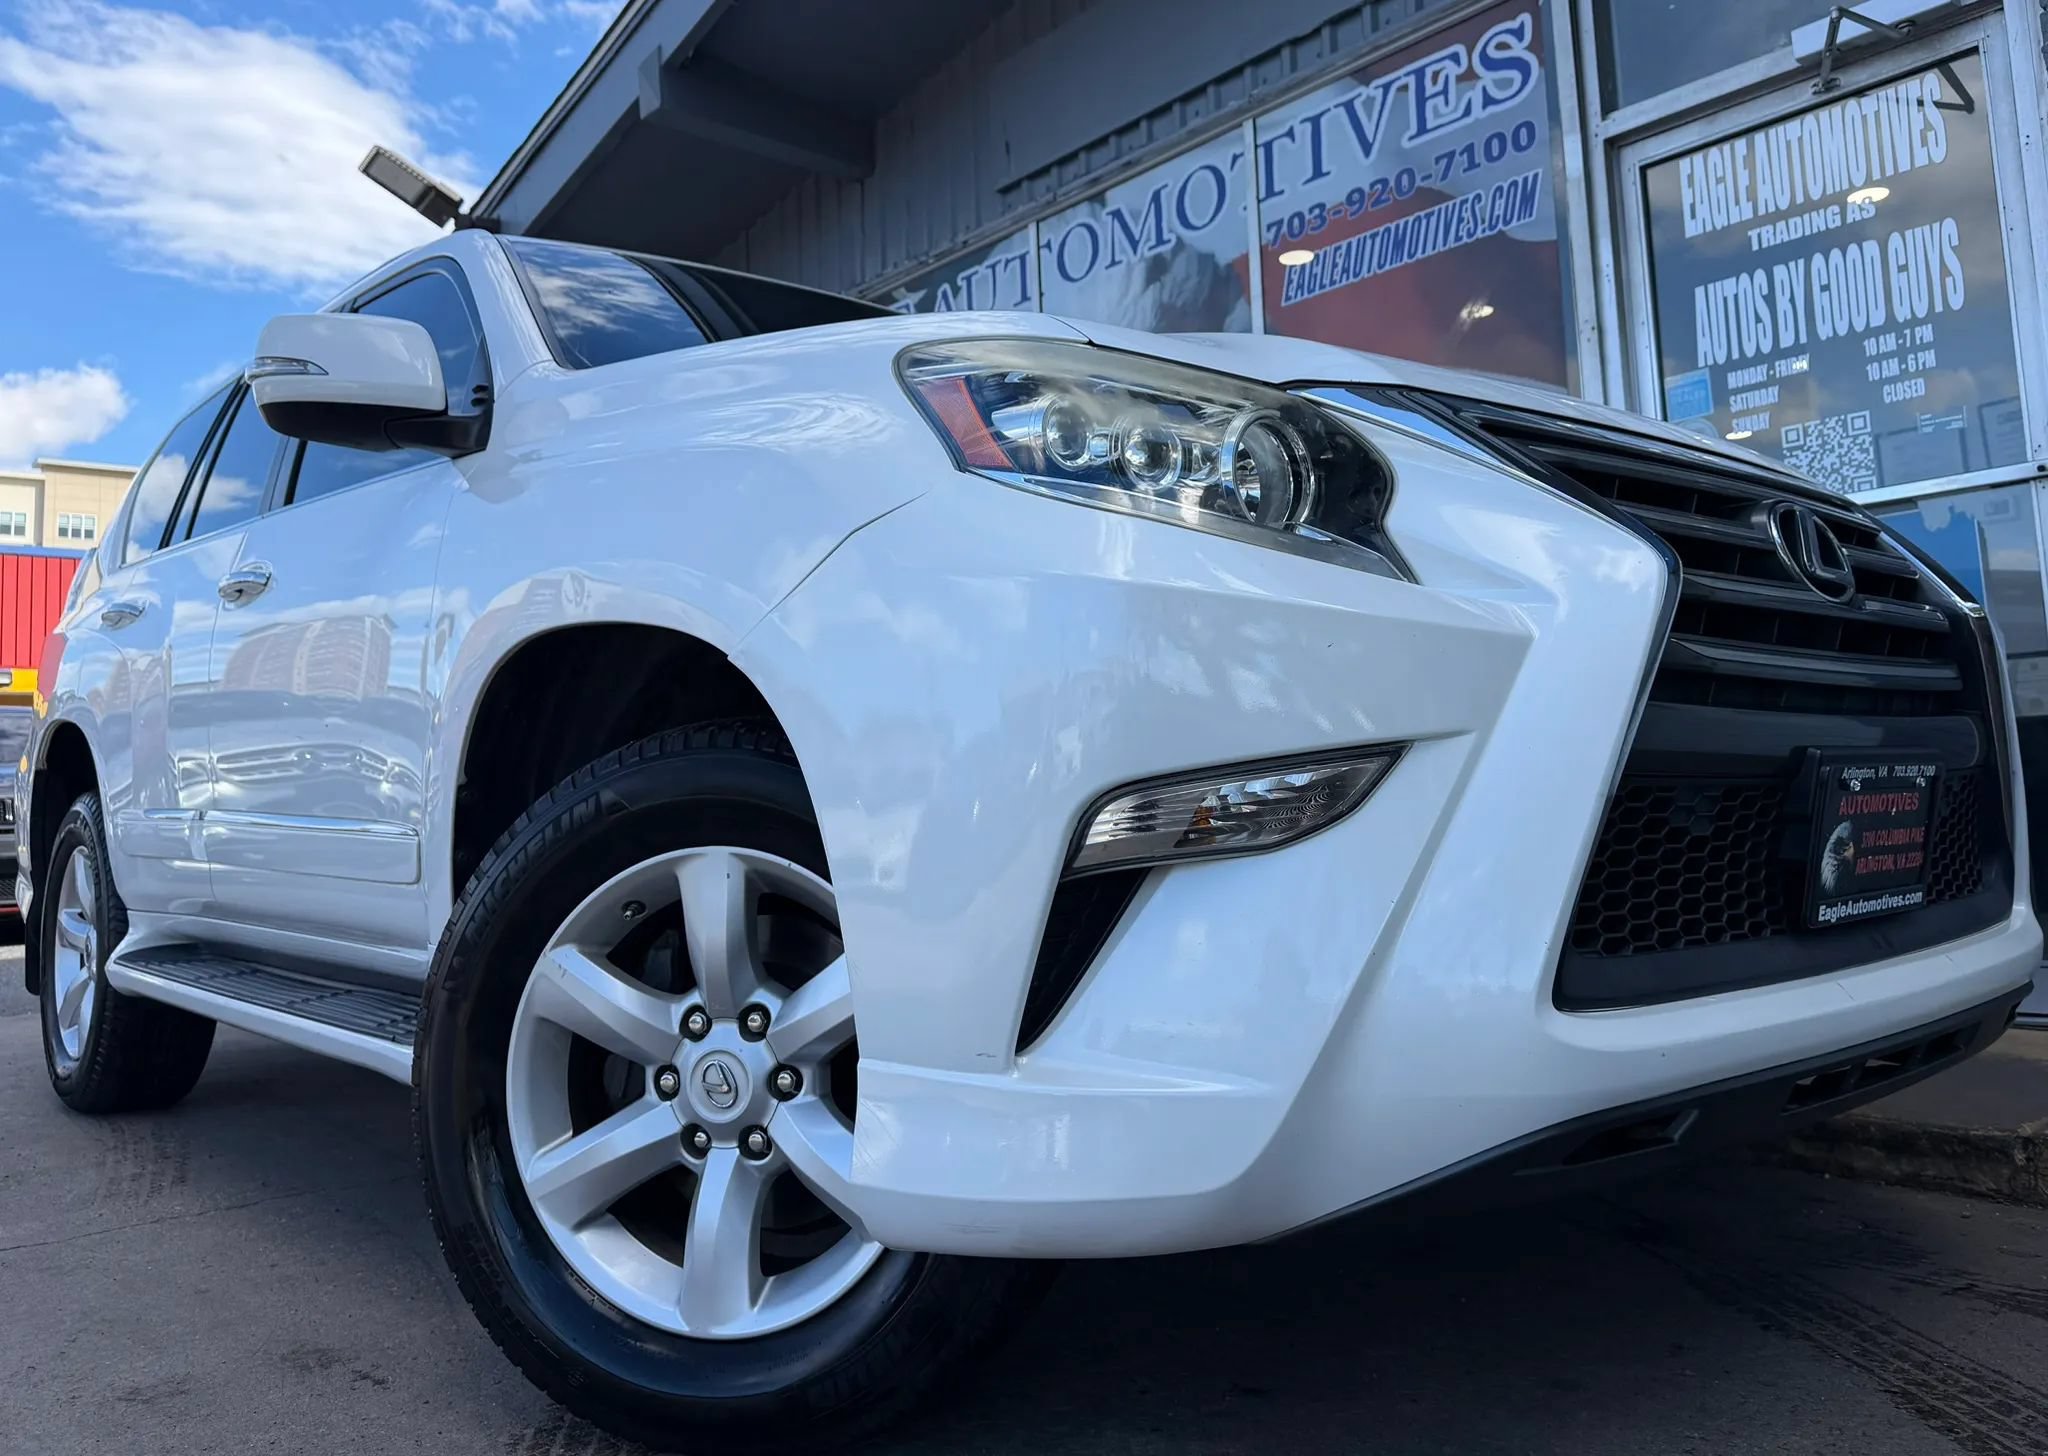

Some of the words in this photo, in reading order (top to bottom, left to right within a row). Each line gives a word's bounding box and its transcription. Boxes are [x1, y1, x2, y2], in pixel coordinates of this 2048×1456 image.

[1679, 139, 1754, 238] EAGLE
[1755, 72, 1947, 215] AUTOMOTIVES
[1266, 120, 1537, 249] 703-920-7100
[1282, 170, 1542, 306] EAGLEAUTOMOTIVES.COM
[1747, 204, 1842, 251] TRADING
[1846, 197, 1877, 226] AS
[1694, 269, 1774, 368] AUTOS
[1773, 258, 1808, 346] BY
[1811, 240, 1886, 342] GOOD
[1887, 218, 1965, 322] GUYS
[1863, 337, 1878, 357] 10
[1878, 332, 1897, 354] AM
[1903, 329, 1912, 348] 7
[1914, 323, 1935, 345] PM
[1727, 364, 1769, 390] MONDAY
[1774, 353, 1811, 379] FRIDAY
[1866, 362, 1880, 382] 10
[1881, 357, 1900, 379] AM
[1907, 353, 1917, 373] 6
[1917, 349, 1937, 371] PM
[1729, 385, 1780, 413] SATURDAY
[1883, 378, 1926, 404] CLOSED
[1732, 411, 1771, 433] SUNDAY
[1841, 767, 1876, 780] Arlington,
[1878, 765, 1888, 777] VA
[1839, 792, 1920, 816] AUTOMOTIVES
[464, 792, 599, 945] MICHELIN
[1818, 891, 1923, 923] EagleAutomotives.com
